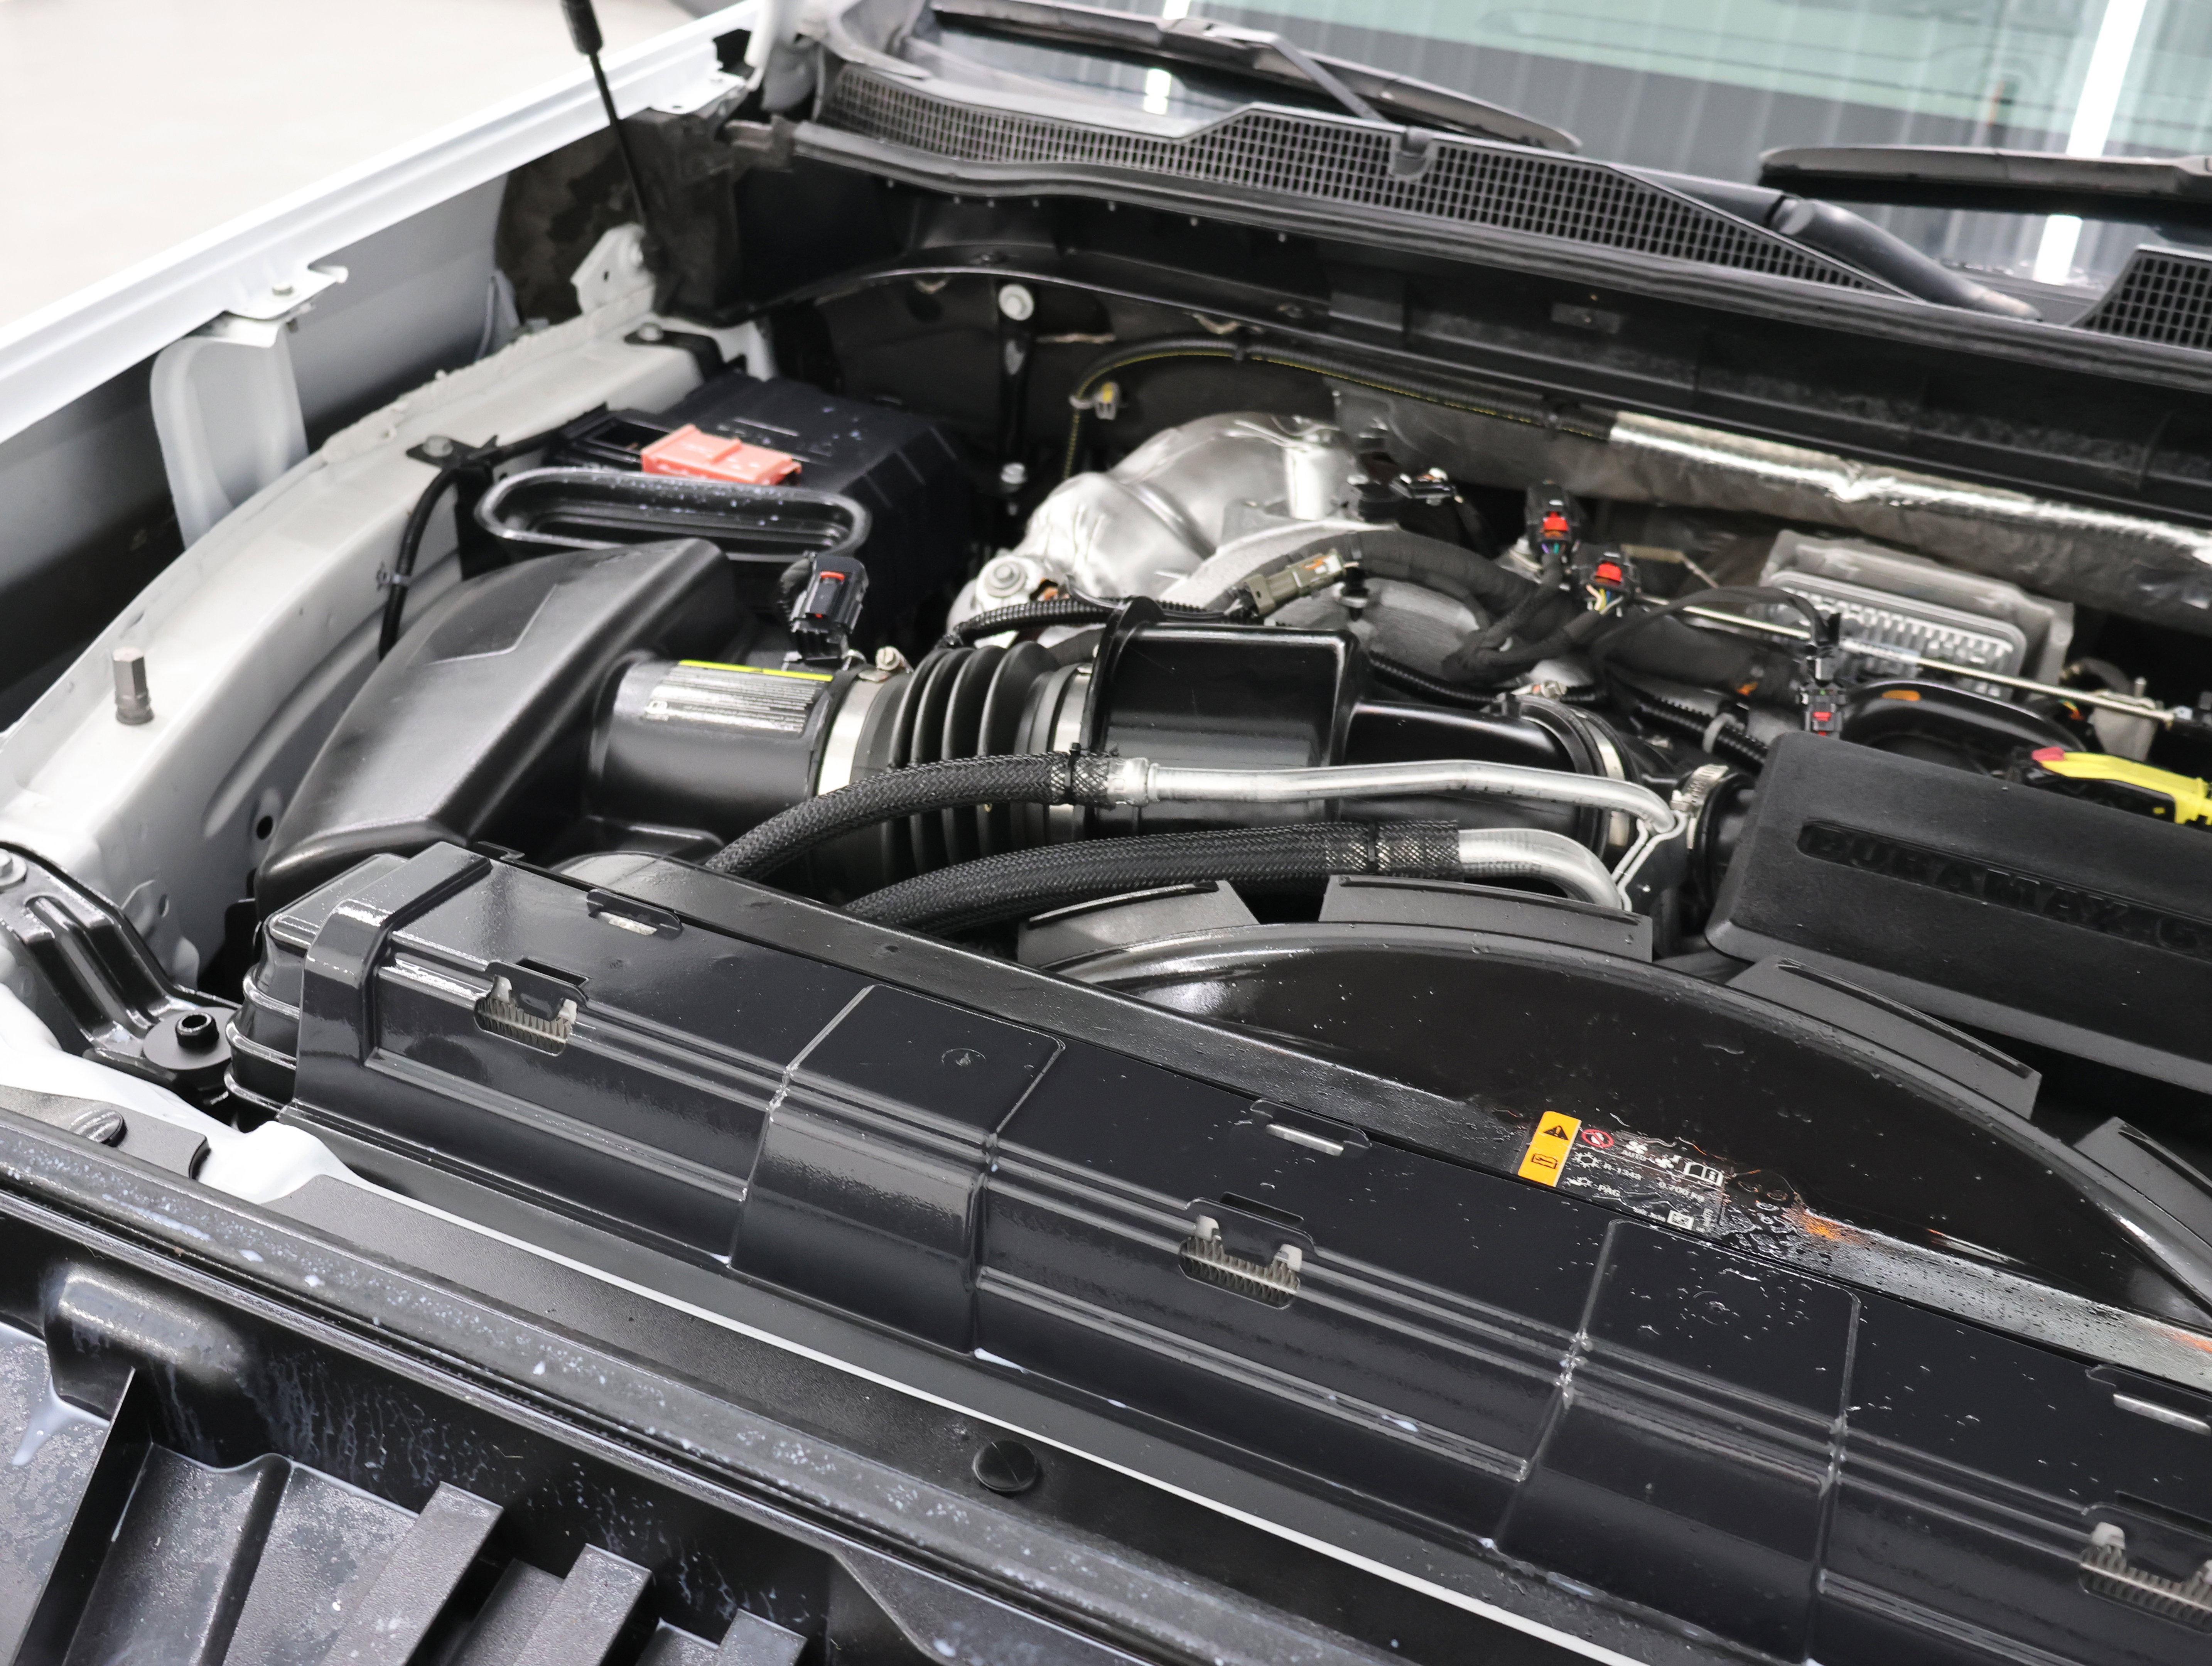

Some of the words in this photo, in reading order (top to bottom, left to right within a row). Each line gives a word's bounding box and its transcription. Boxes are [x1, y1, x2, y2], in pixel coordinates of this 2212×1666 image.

[1806, 828, 2128, 936] DURAMAX
[1621, 1150, 1646, 1162] AUTO
[1603, 1163, 1642, 1180] R-134a
[1598, 1184, 1620, 1196] PAG
[1659, 1182, 1689, 1196] 0.700
